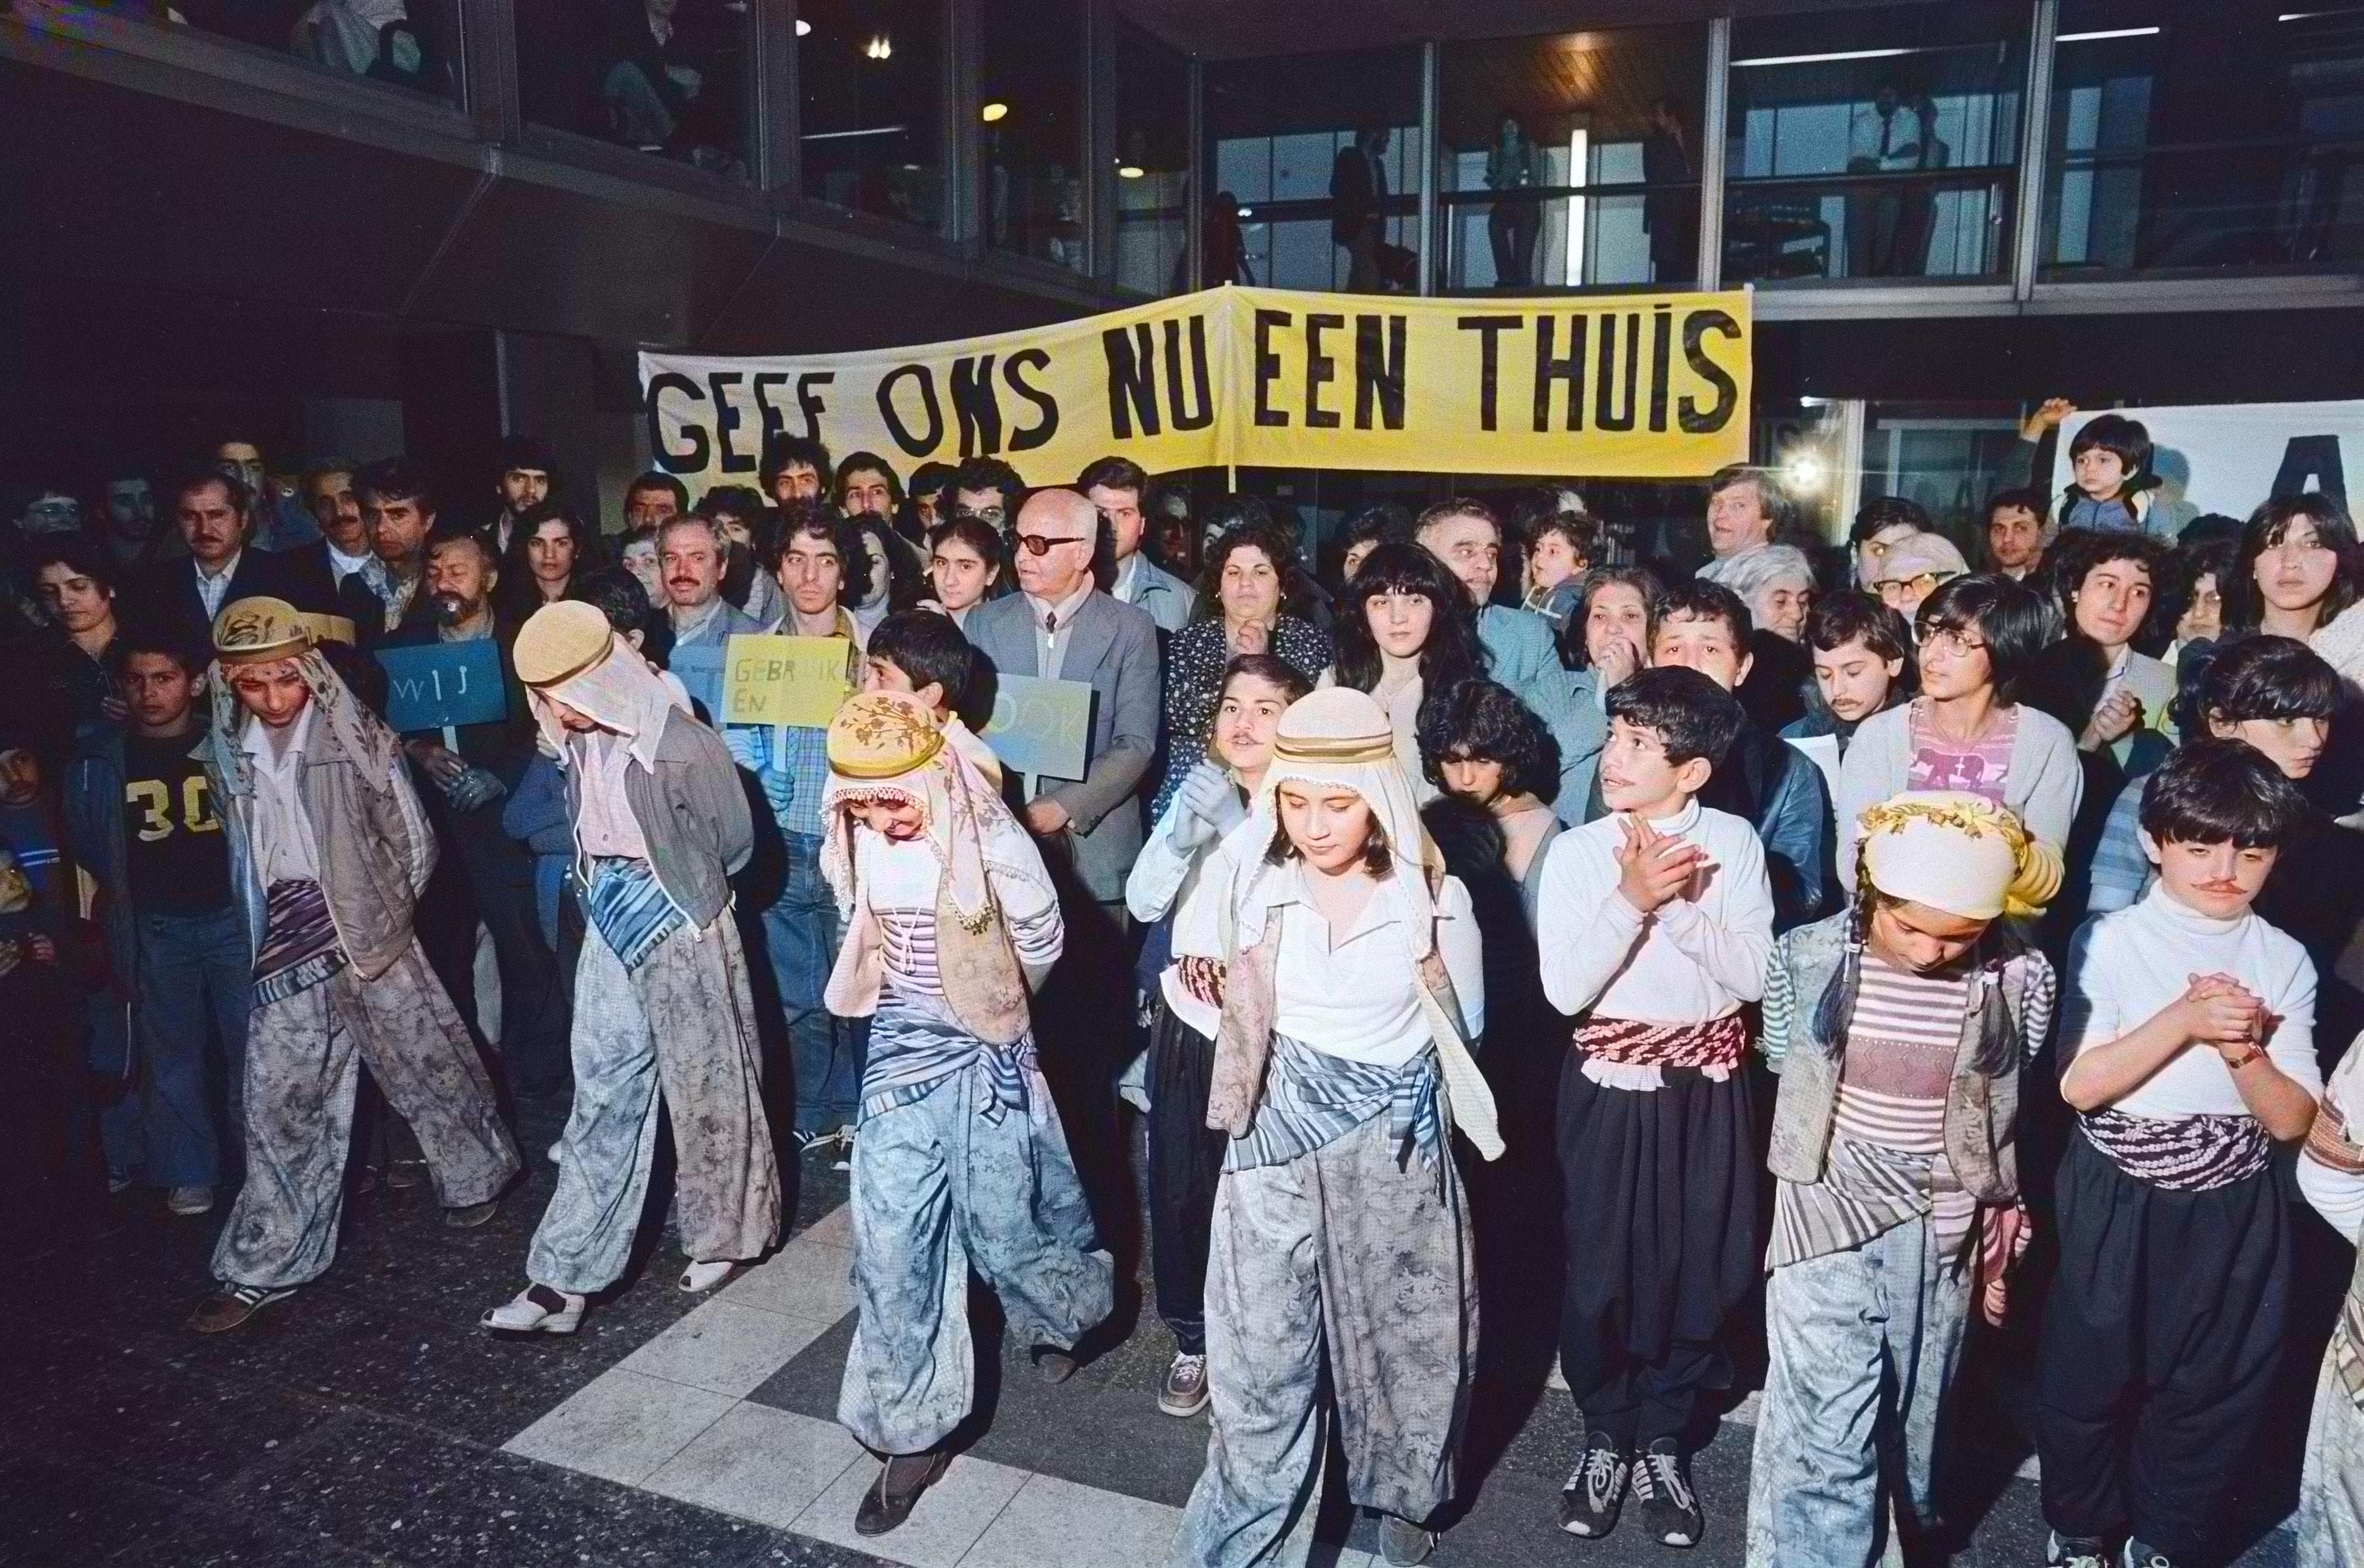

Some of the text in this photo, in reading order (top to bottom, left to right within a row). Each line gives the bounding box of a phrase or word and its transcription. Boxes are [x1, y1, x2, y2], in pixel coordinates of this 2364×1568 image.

[875, 347, 1059, 457] ONS
[1102, 315, 1213, 439] NU
[1255, 309, 1407, 430] EEN
[393, 665, 467, 701] WIJ
[733, 687, 768, 713] EN
